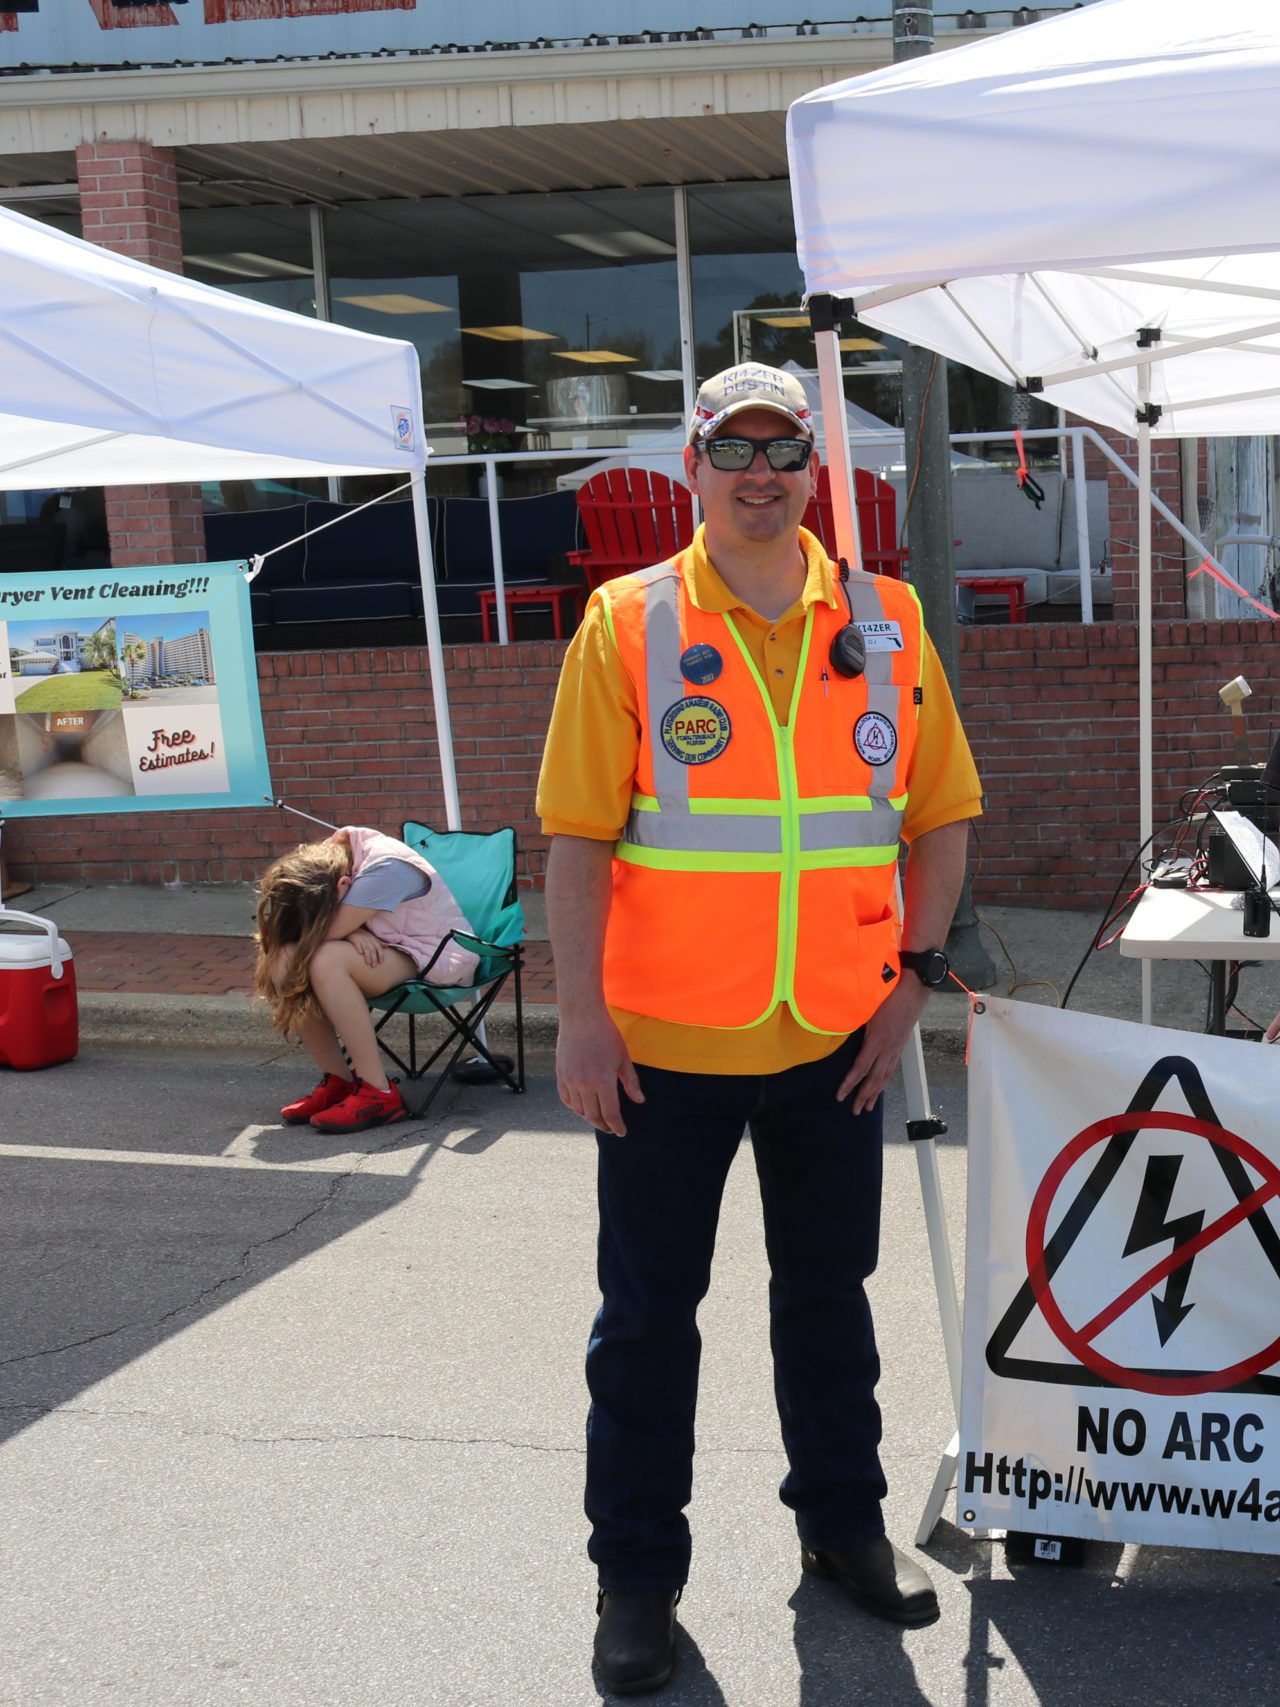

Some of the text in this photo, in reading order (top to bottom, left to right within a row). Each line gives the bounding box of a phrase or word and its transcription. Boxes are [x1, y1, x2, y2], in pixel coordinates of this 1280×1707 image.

[724, 379, 785, 396] DUSTIN
[0, 577, 210, 606] ryer Vent Cleaning!!!
[56, 717, 85, 727] AFTER
[674, 719, 717, 735] PARC
[147, 728, 195, 752] Free
[139, 742, 216, 773] Estimates!
[1077, 1405, 1264, 1463] NO ARC
